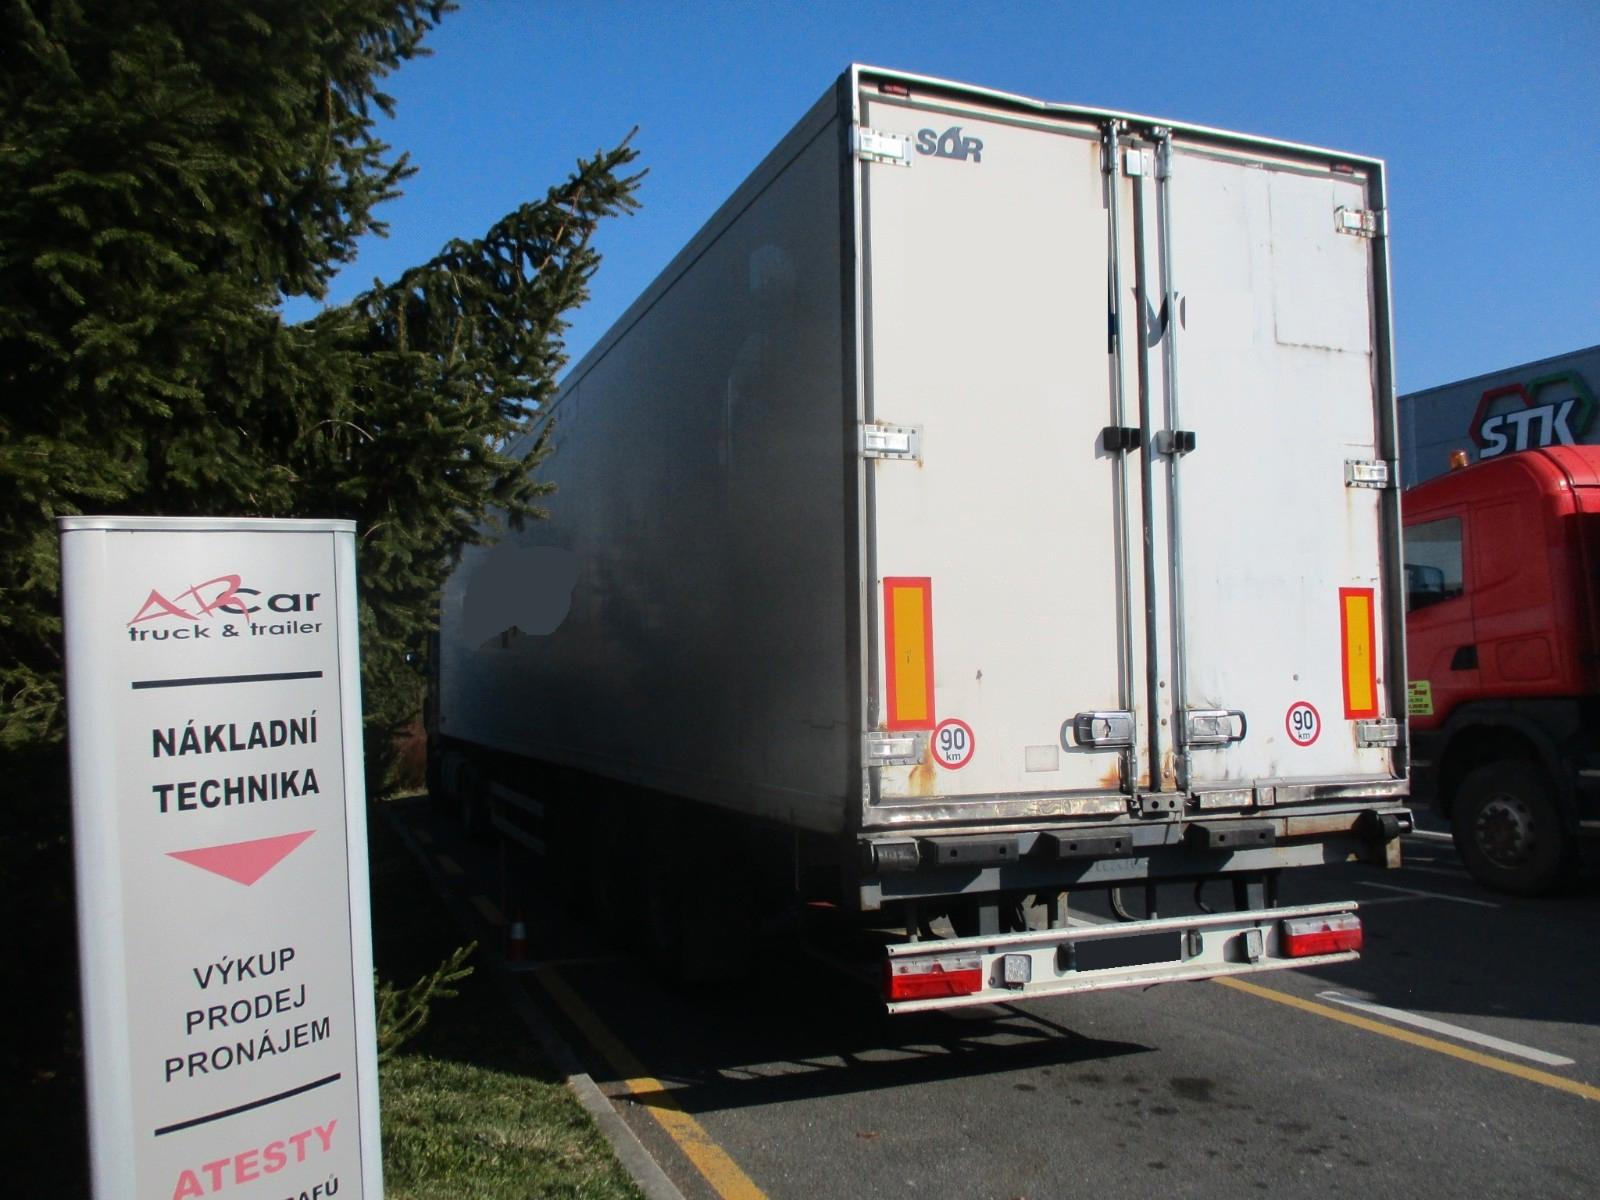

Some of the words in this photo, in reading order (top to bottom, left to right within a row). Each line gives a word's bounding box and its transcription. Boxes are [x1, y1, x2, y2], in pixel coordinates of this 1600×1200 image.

[1480, 399, 1576, 459] STK
[128, 625, 210, 642] truck
[222, 624, 240, 638] &
[250, 621, 322, 636] trailer
[152, 709, 318, 758] NÁKLADNÍ
[940, 728, 965, 751] 90
[1293, 710, 1313, 731] 90
[1298, 732, 1311, 740] km
[946, 752, 961, 761] km
[152, 768, 320, 813] TECHNIKA
[193, 947, 295, 989] VÝKUP
[186, 984, 306, 1035] PRODEJ
[164, 1016, 331, 1083] PRONÁJEM
[171, 1119, 338, 1200] ATESTY
